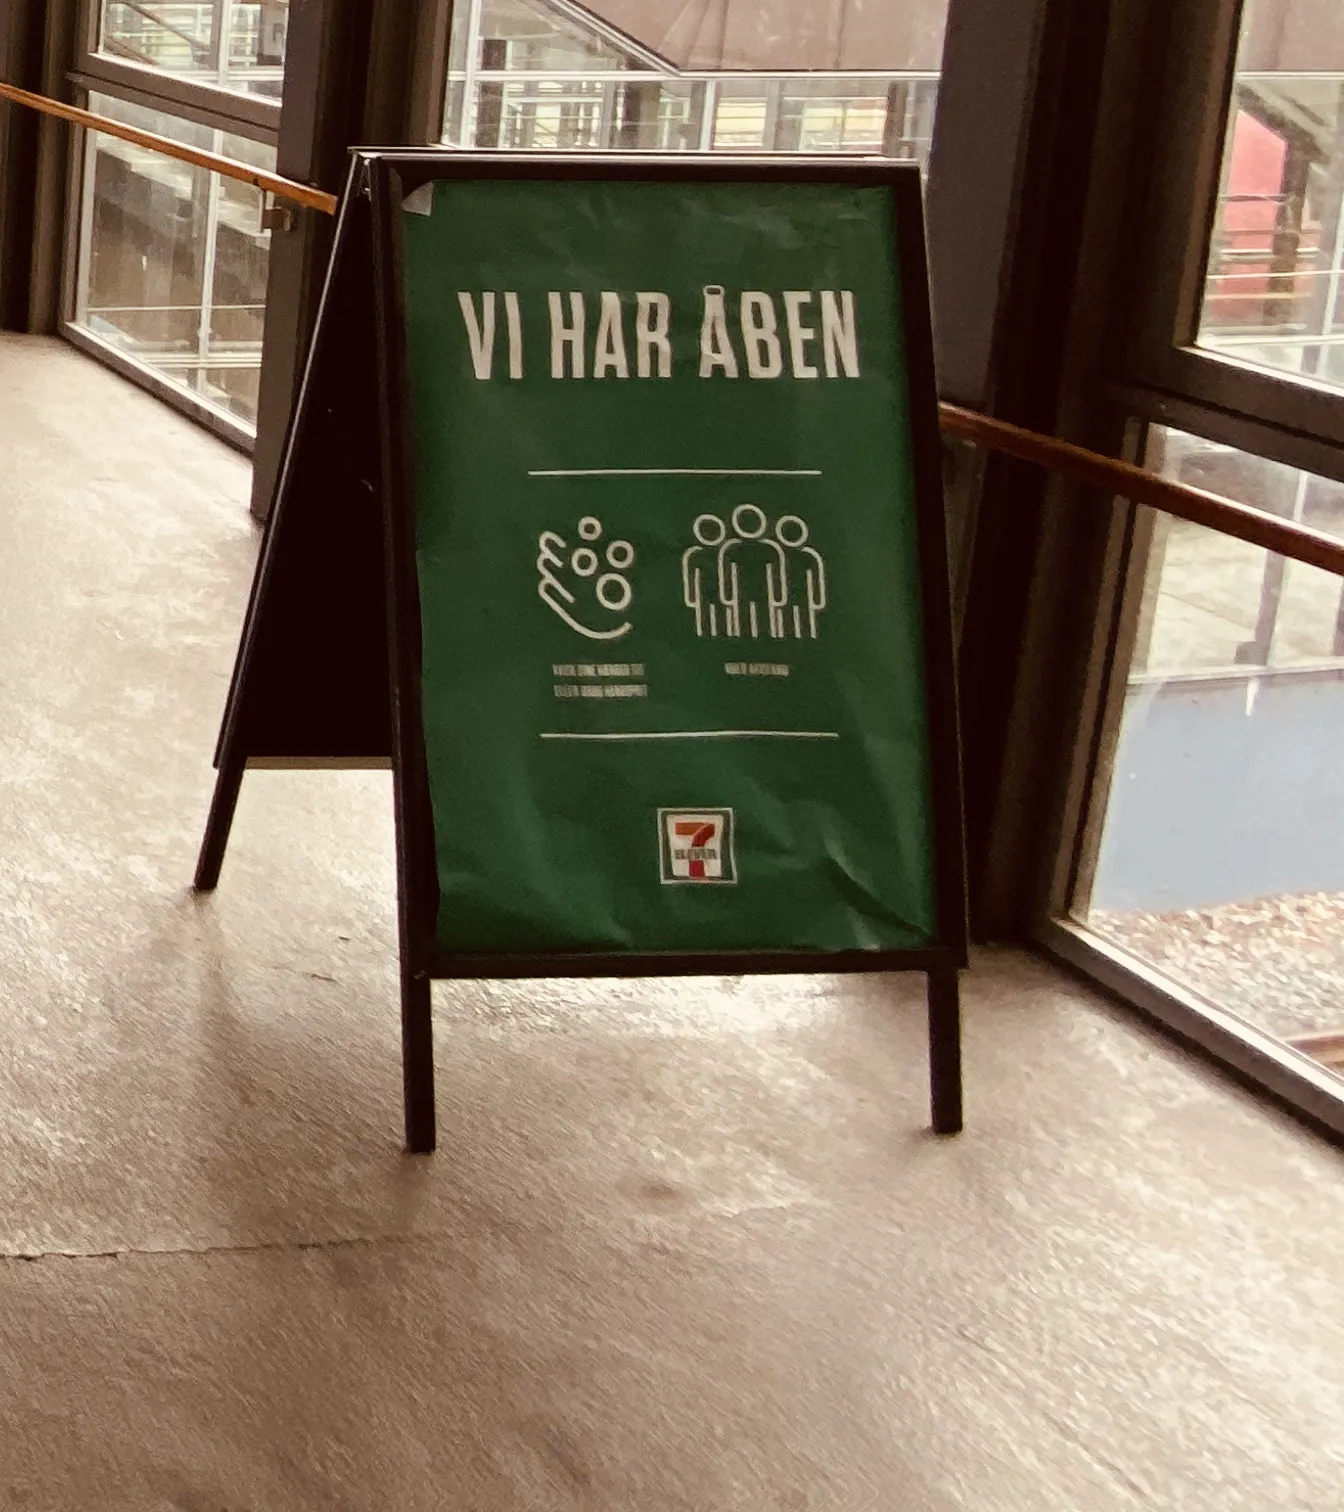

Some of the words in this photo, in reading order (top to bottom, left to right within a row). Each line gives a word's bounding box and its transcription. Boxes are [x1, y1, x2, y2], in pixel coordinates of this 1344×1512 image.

[457, 291, 523, 380] VI
[548, 291, 672, 379] HAR
[698, 285, 860, 379] ÅBEN
[675, 822, 716, 878] 7
